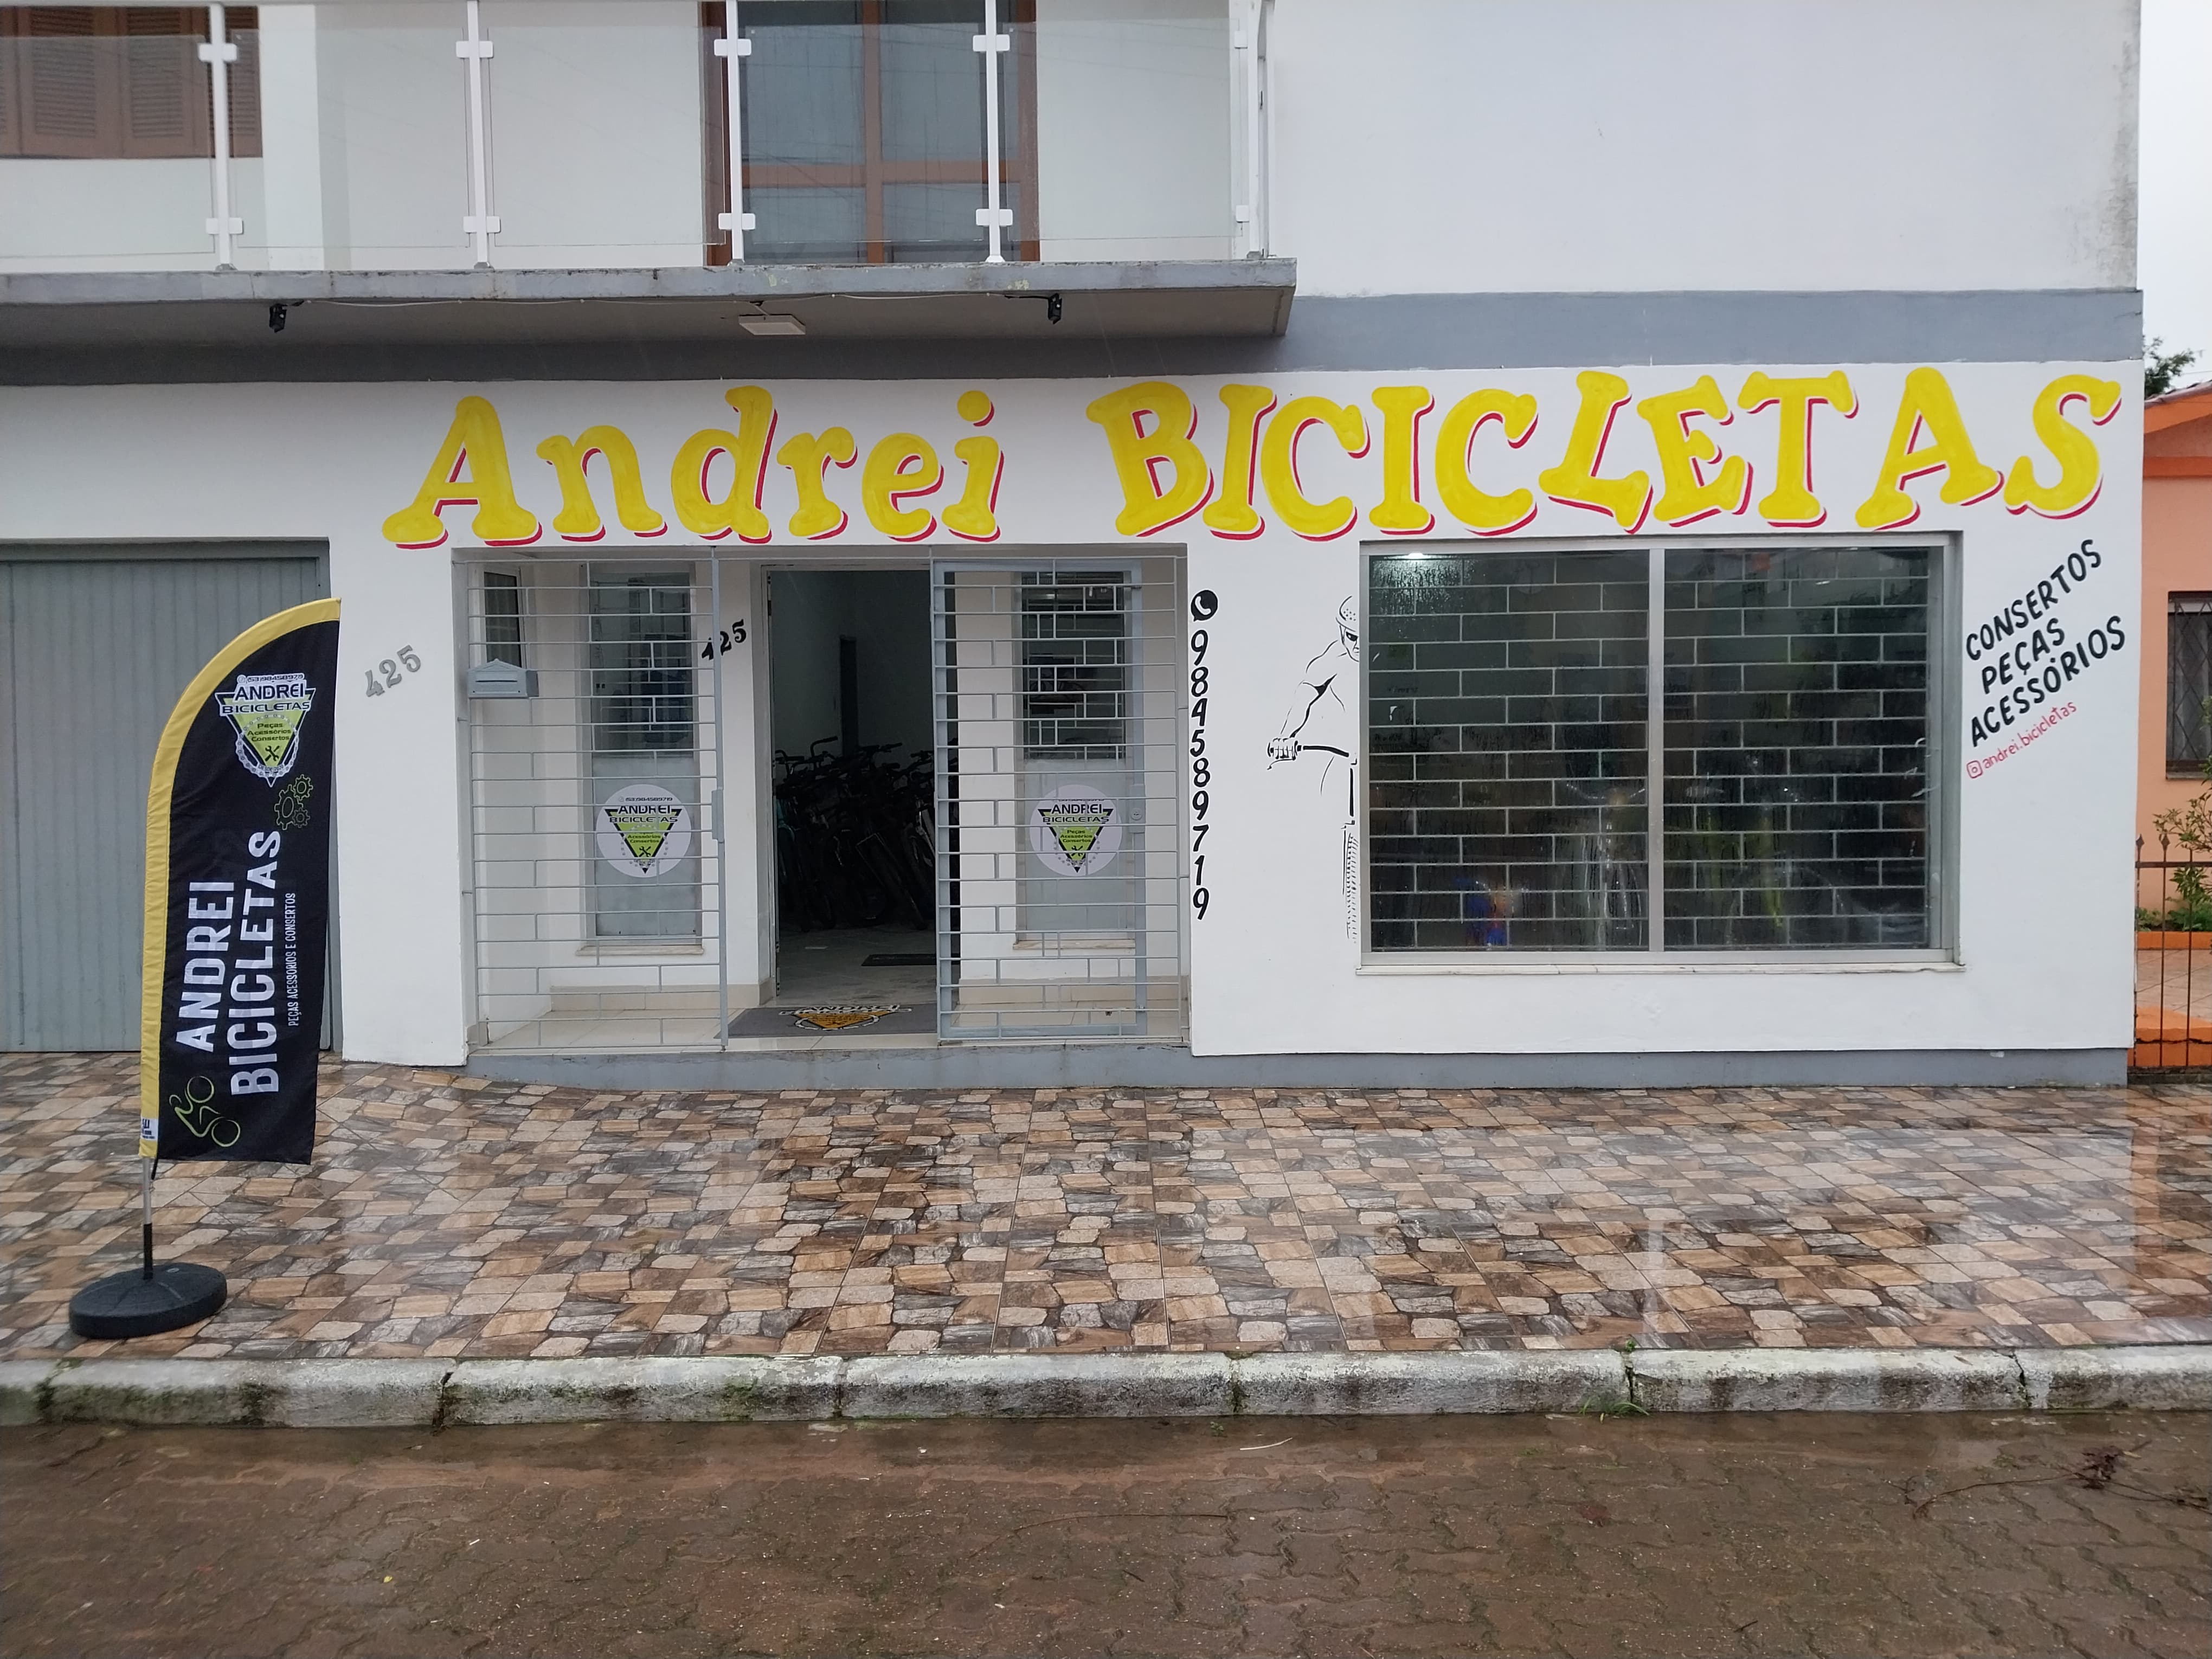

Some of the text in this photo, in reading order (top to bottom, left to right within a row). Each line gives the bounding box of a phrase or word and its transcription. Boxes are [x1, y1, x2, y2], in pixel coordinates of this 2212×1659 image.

[382, 367, 2121, 548] Andrei BICICLETAS
[1966, 539, 2101, 661] CONSERTOS
[702, 619, 747, 660] 425
[1982, 618, 2065, 695] PEÇAS
[234, 683, 304, 701] ANDREI
[364, 645, 421, 698] 425
[222, 702, 310, 713] BICICLETAS
[1982, 702, 2077, 769] andrei.bicicletas
[1190, 629, 1211, 921] 984589719
[618, 805, 671, 814] ANDREI
[1051, 803, 1102, 814] ANDREI
[285, 892, 296, 941] CONSERTOS
[175, 882, 235, 1053] ANDREI
[226, 831, 281, 1096] BICICLETAS
[285, 951, 299, 999] ACESSORIOS
[288, 1001, 302, 1026] PEÇAS
